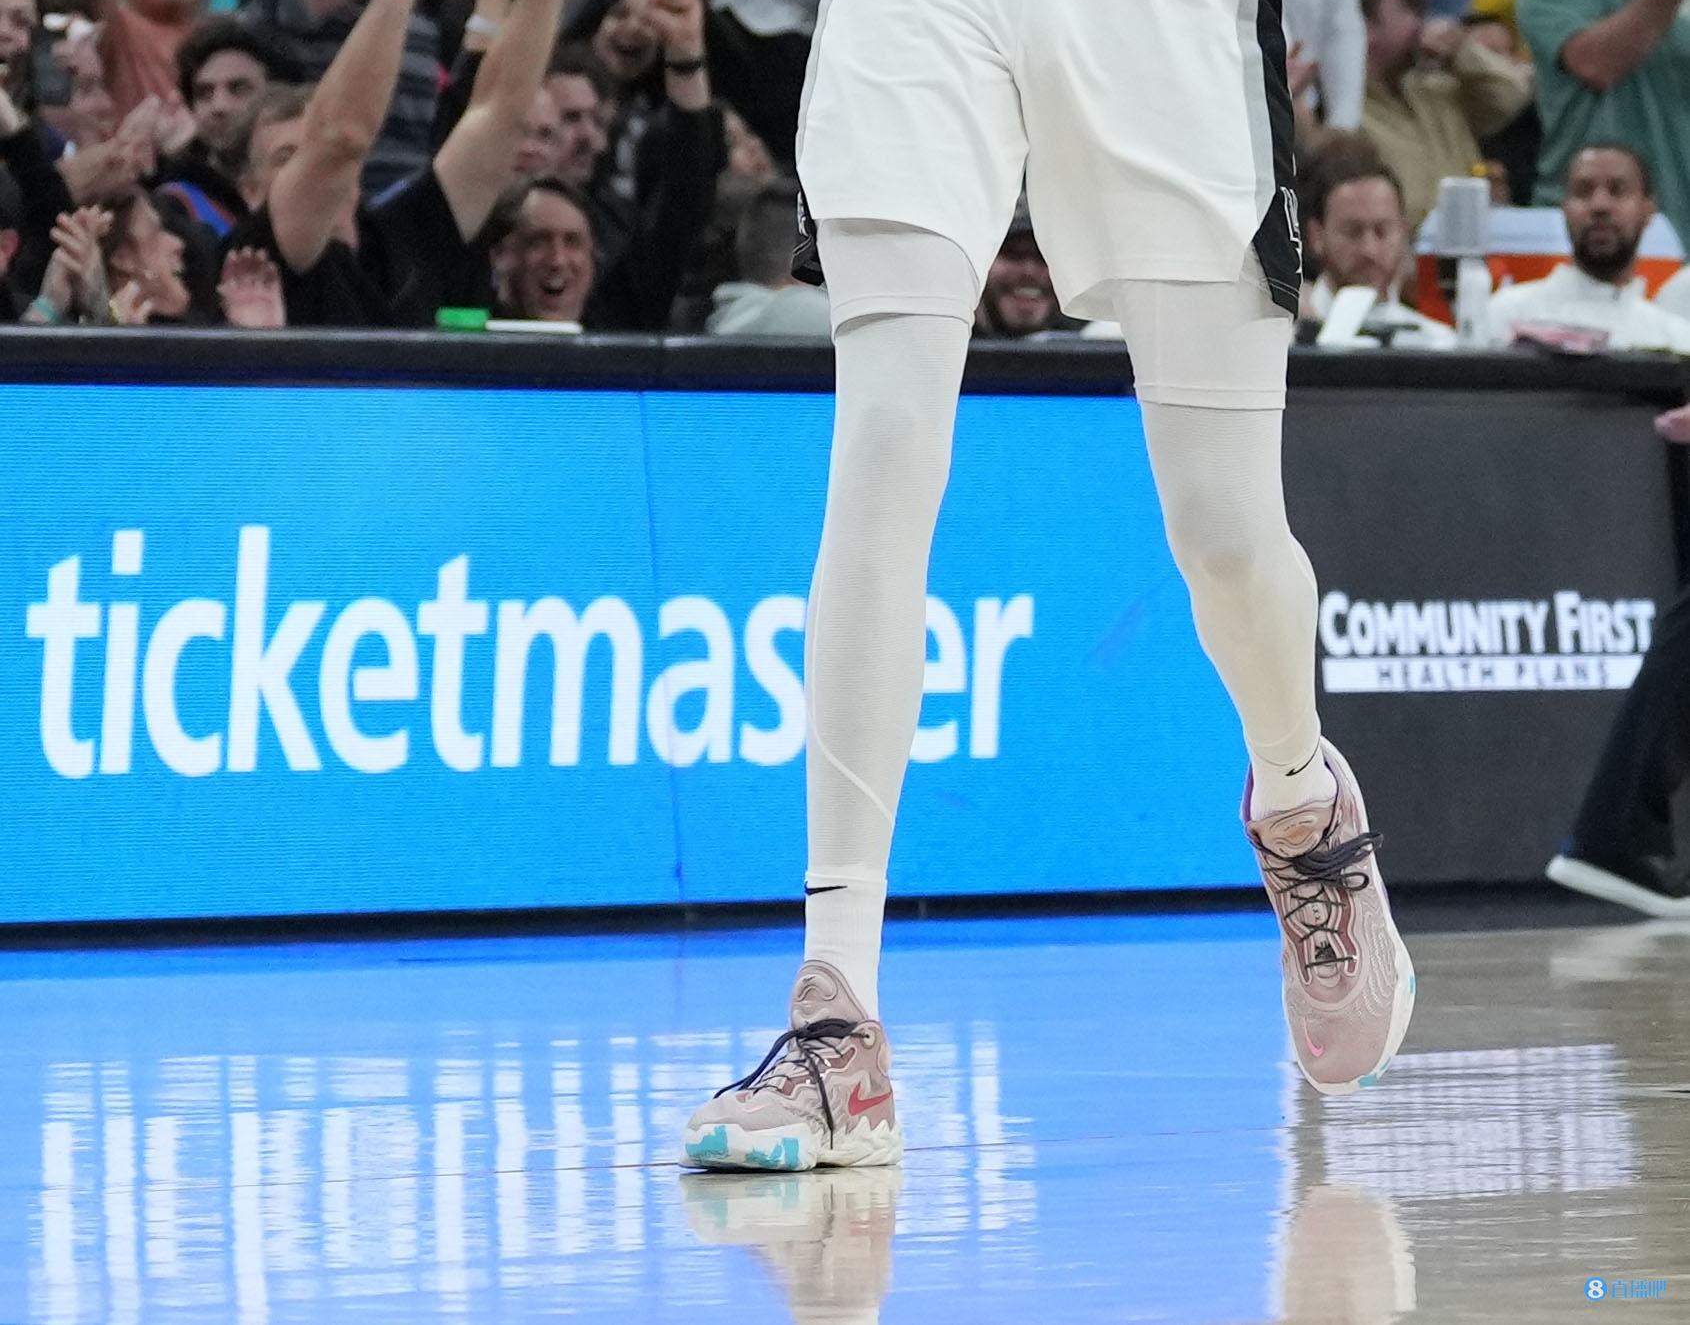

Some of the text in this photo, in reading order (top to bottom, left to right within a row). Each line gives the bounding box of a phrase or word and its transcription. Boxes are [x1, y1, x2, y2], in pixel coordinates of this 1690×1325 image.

[25, 524, 1034, 780] ticketmaser
[1318, 589, 1656, 657] COMMUNITY FIRST
